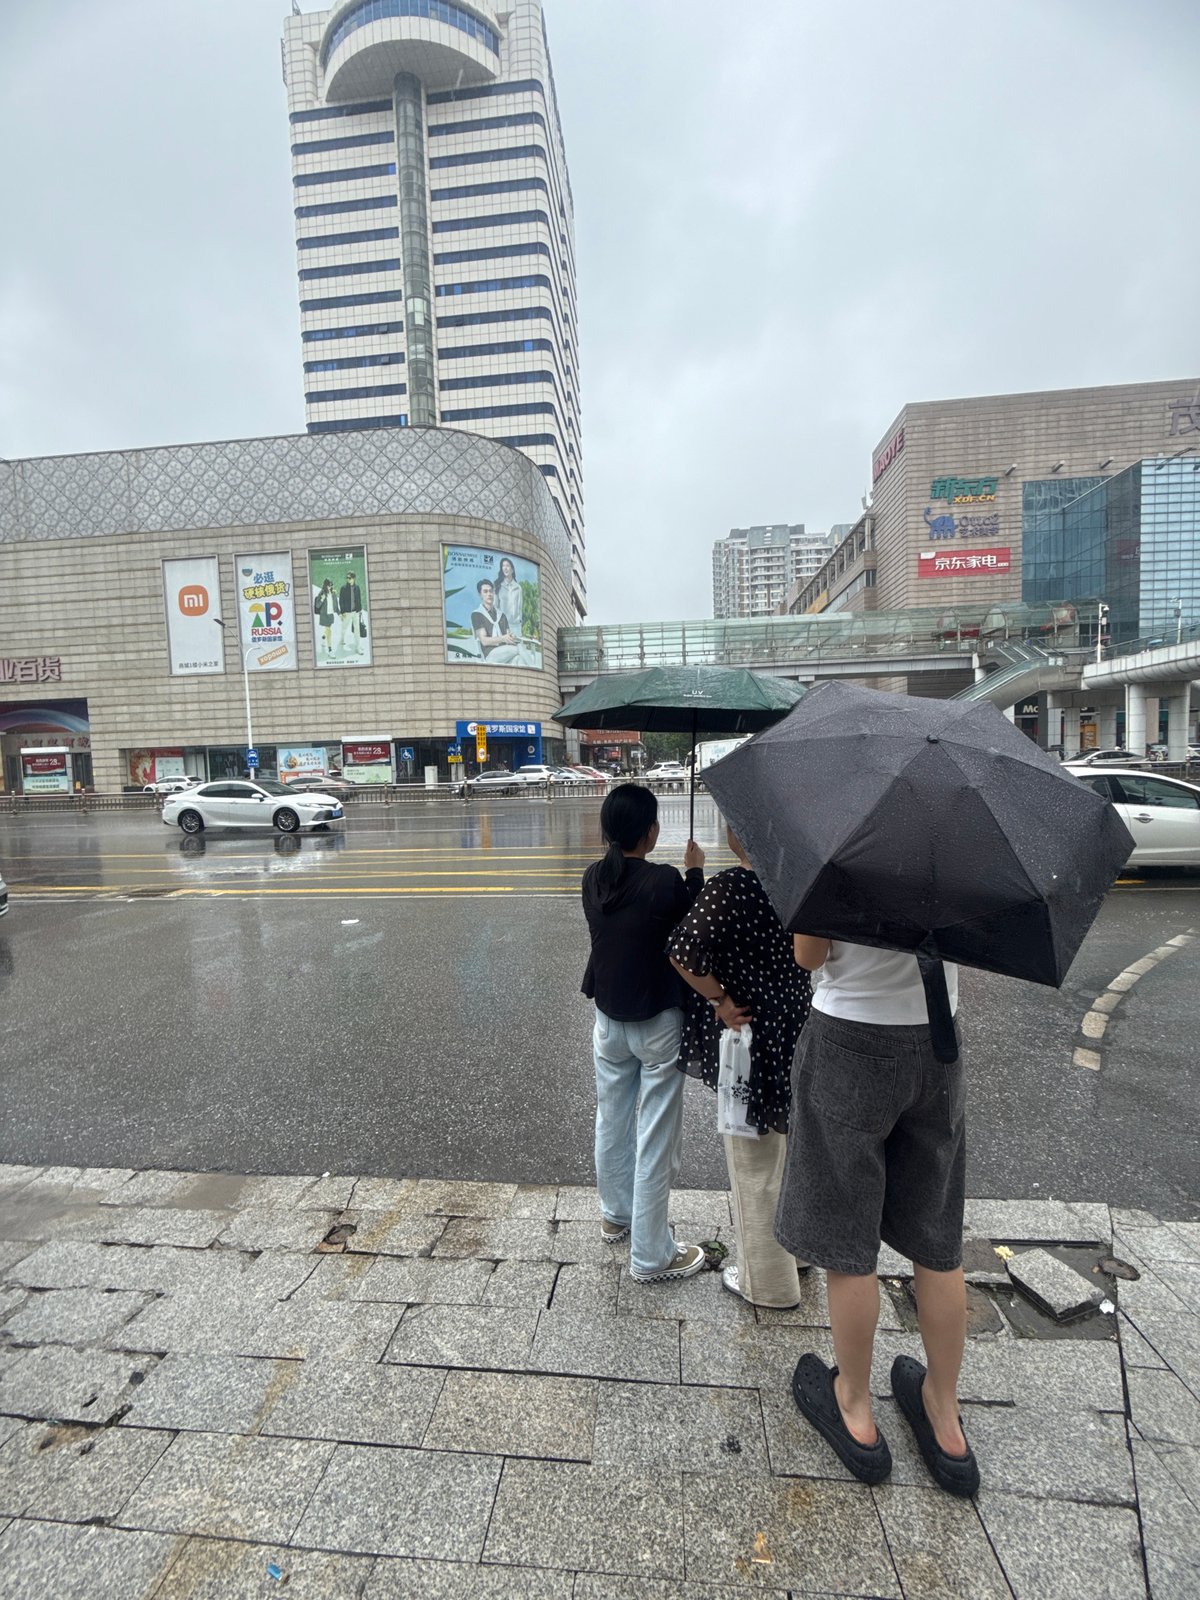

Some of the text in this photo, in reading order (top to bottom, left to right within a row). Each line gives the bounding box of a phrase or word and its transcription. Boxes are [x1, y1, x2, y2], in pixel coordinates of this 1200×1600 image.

[930, 476, 999, 504] 新东方
[953, 494, 996, 505] XDF.CN
[935, 554, 998, 571] 京东家电
[251, 627, 282, 636] RUSSIA
